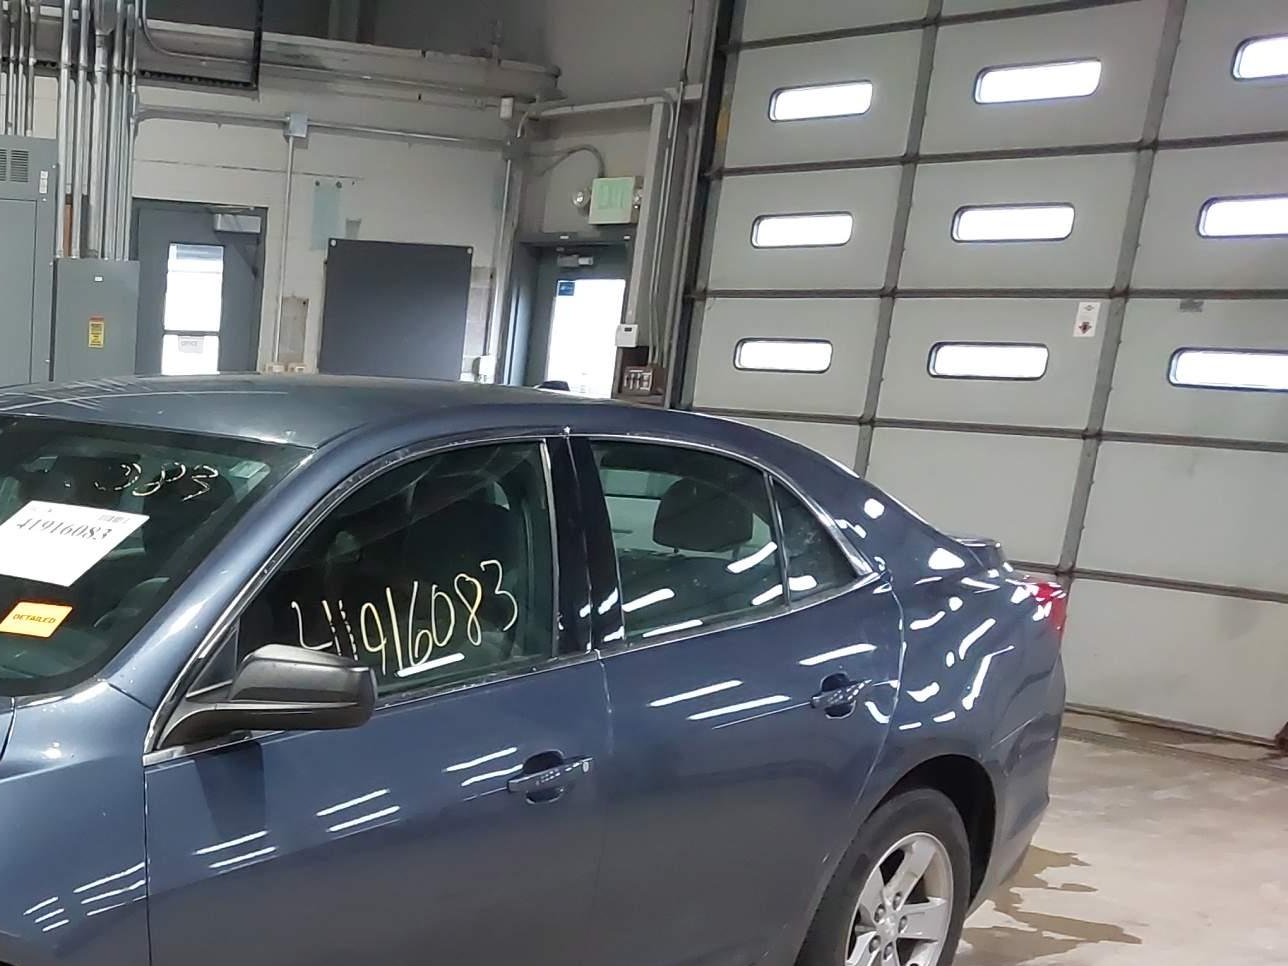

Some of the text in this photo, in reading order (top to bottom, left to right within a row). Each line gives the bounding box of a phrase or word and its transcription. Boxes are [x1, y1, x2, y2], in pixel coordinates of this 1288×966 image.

[15, 517, 113, 541] 41916083
[12, 613, 57, 624] DETAILED
[290, 559, 519, 676] 41916083
